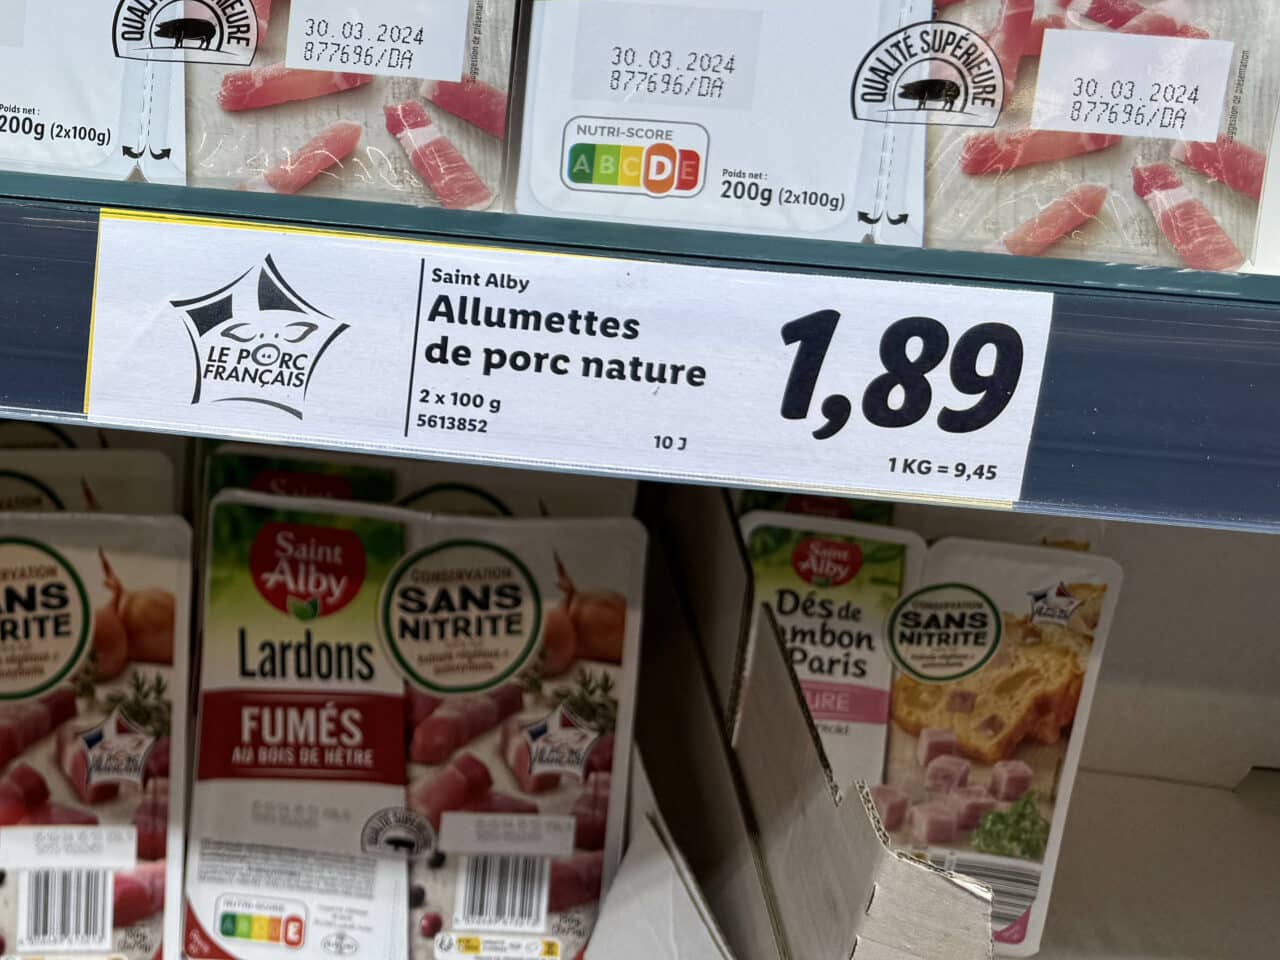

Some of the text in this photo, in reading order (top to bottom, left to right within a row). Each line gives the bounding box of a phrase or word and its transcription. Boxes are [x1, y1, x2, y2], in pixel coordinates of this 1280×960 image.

[304, 18, 424, 46] 30.03.2024
[303, 42, 413, 70] 877696/DA
[611, 47, 736, 75] 30.03.2024
[861, 27, 996, 109] QUALITÉ SUPÉRIEURE
[609, 70, 724, 99] 877696/DA
[1073, 78, 1199, 105] 30.03.2024
[1070, 100, 1186, 129] 877696/DA
[50, 122, 111, 146] (2x100g)
[576, 124, 673, 141] NUTRI-SCORE
[648, 155, 672, 181] D
[722, 168, 747, 179] Poids
[720, 180, 845, 212] 200g (2x100g)
[431, 267, 530, 293] Saint Alby
[427, 293, 641, 340] Allumettes
[208, 343, 308, 371] LE PORC
[424, 335, 707, 388] de porc nature
[203, 363, 305, 389] FRANÇAIS
[780, 308, 1024, 441] 1,89
[419, 389, 501, 413] 2 x 100 g
[417, 413, 488, 433] 5613852
[653, 435, 687, 451] 10 J
[888, 457, 997, 482] 1 KG = 9,45
[275, 531, 342, 563] Saint
[809, 541, 849, 559] Saint
[799, 555, 851, 580] Alby
[262, 560, 348, 605] Alby
[397, 584, 522, 614] SANS
[776, 589, 862, 622] Dés de
[398, 614, 522, 642] NITRITE
[900, 611, 988, 629] SANS
[899, 631, 987, 646] NITRITE
[238, 628, 374, 682] Lardons
[790, 647, 867, 678] Paris
[241, 700, 363, 748] FUMÉS
